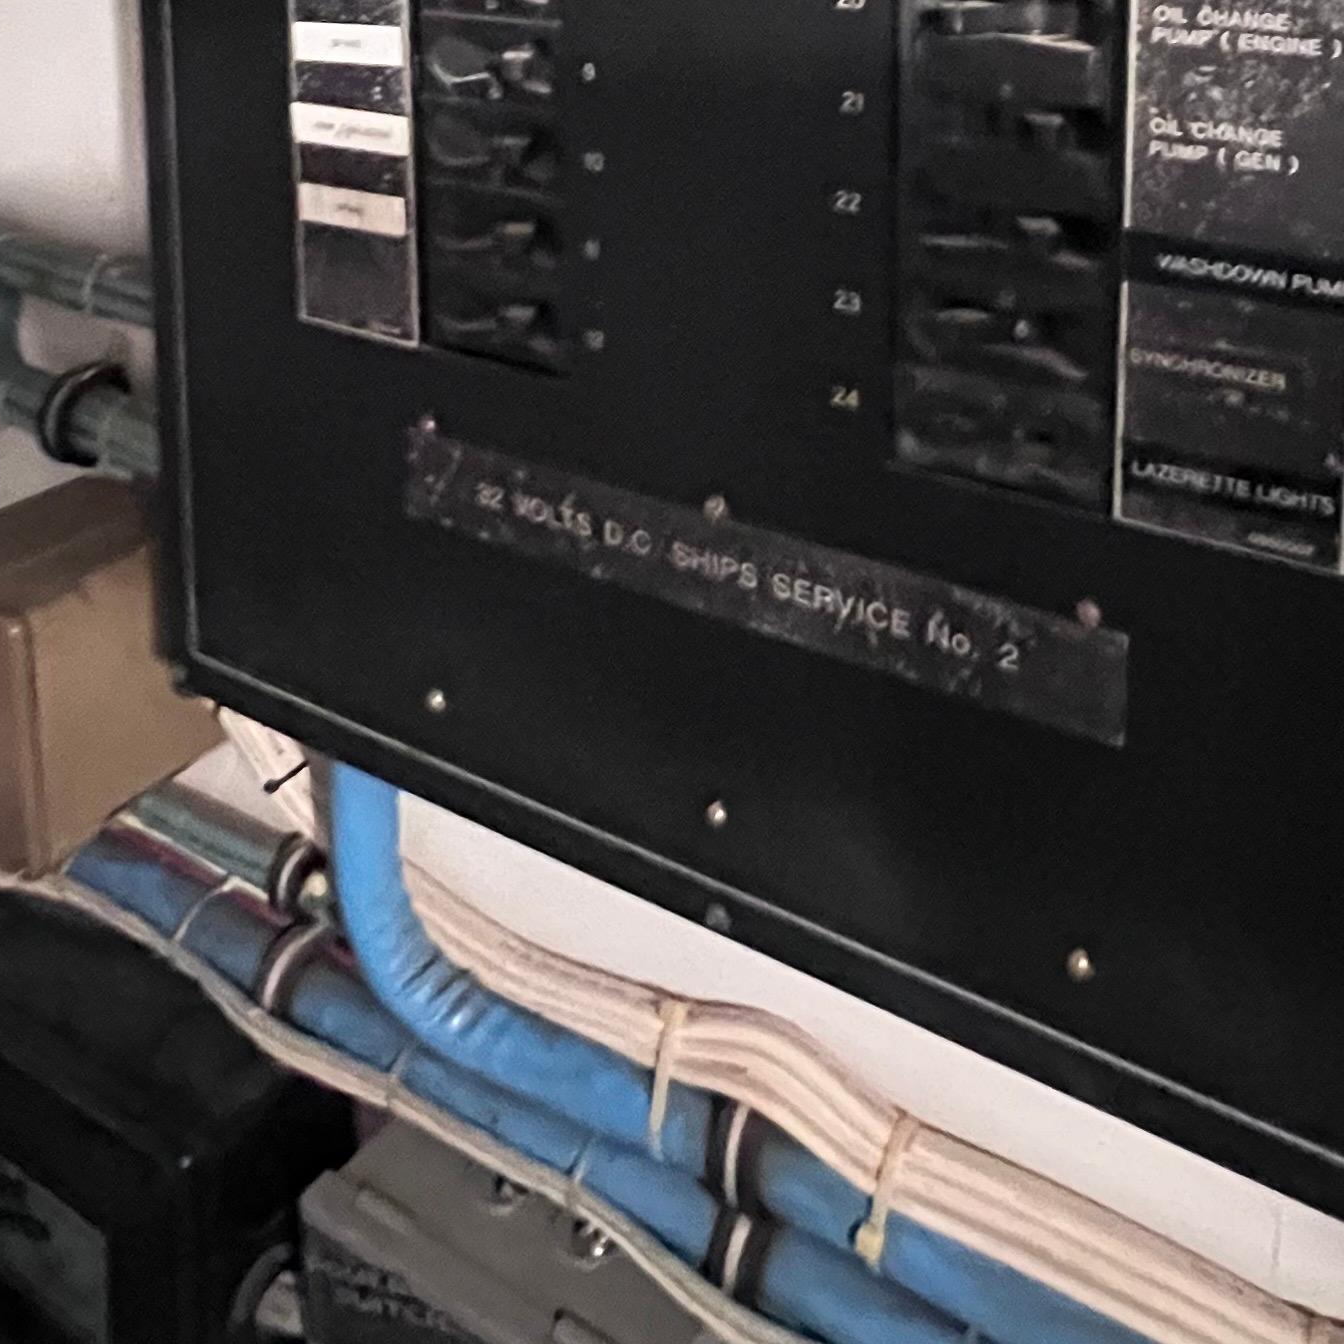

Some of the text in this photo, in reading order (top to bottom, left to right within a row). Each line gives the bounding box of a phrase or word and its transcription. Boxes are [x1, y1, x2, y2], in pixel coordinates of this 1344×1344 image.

[1153, 4, 1291, 32] OIL CHANGE
[1150, 27, 1218, 46] PUMP
[840, 91, 865, 115] 21
[1149, 117, 1284, 147] OIL CHANGE
[1148, 140, 1209, 160] PUMP
[834, 189, 862, 215] 22
[1158, 253, 1288, 290] WASHDOWN
[833, 289, 862, 315] 23
[1131, 459, 1336, 517] LAZERETTE LIGHTS
[669, 541, 758, 589] SHIPS
[771, 572, 912, 639] SERVICE
[997, 642, 1020, 670] 2
